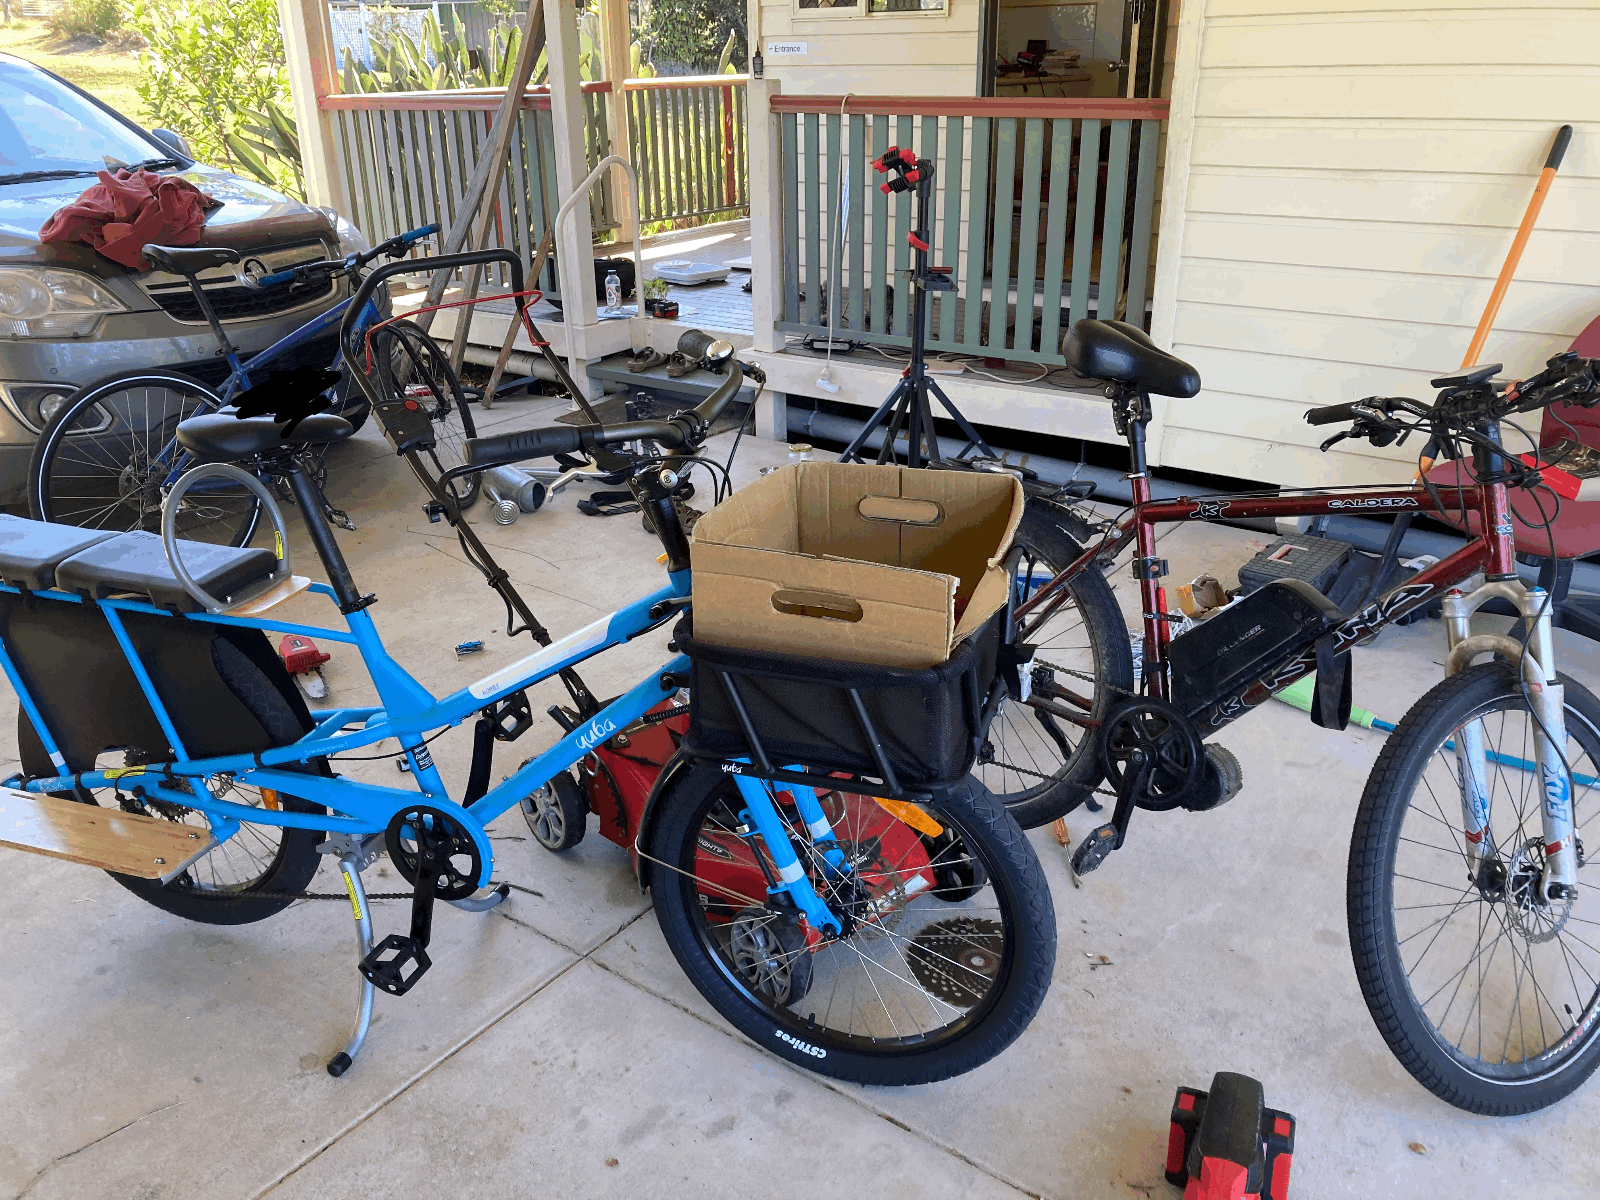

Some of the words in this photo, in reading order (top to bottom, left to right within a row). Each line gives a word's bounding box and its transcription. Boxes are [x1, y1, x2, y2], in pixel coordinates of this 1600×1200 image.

[774, 45, 801, 53] Entrance
[1327, 497, 1419, 508] CALDERA
[575, 718, 617, 749] yuba
[721, 762, 743, 773] yuba
[1541, 762, 1569, 822] FOX
